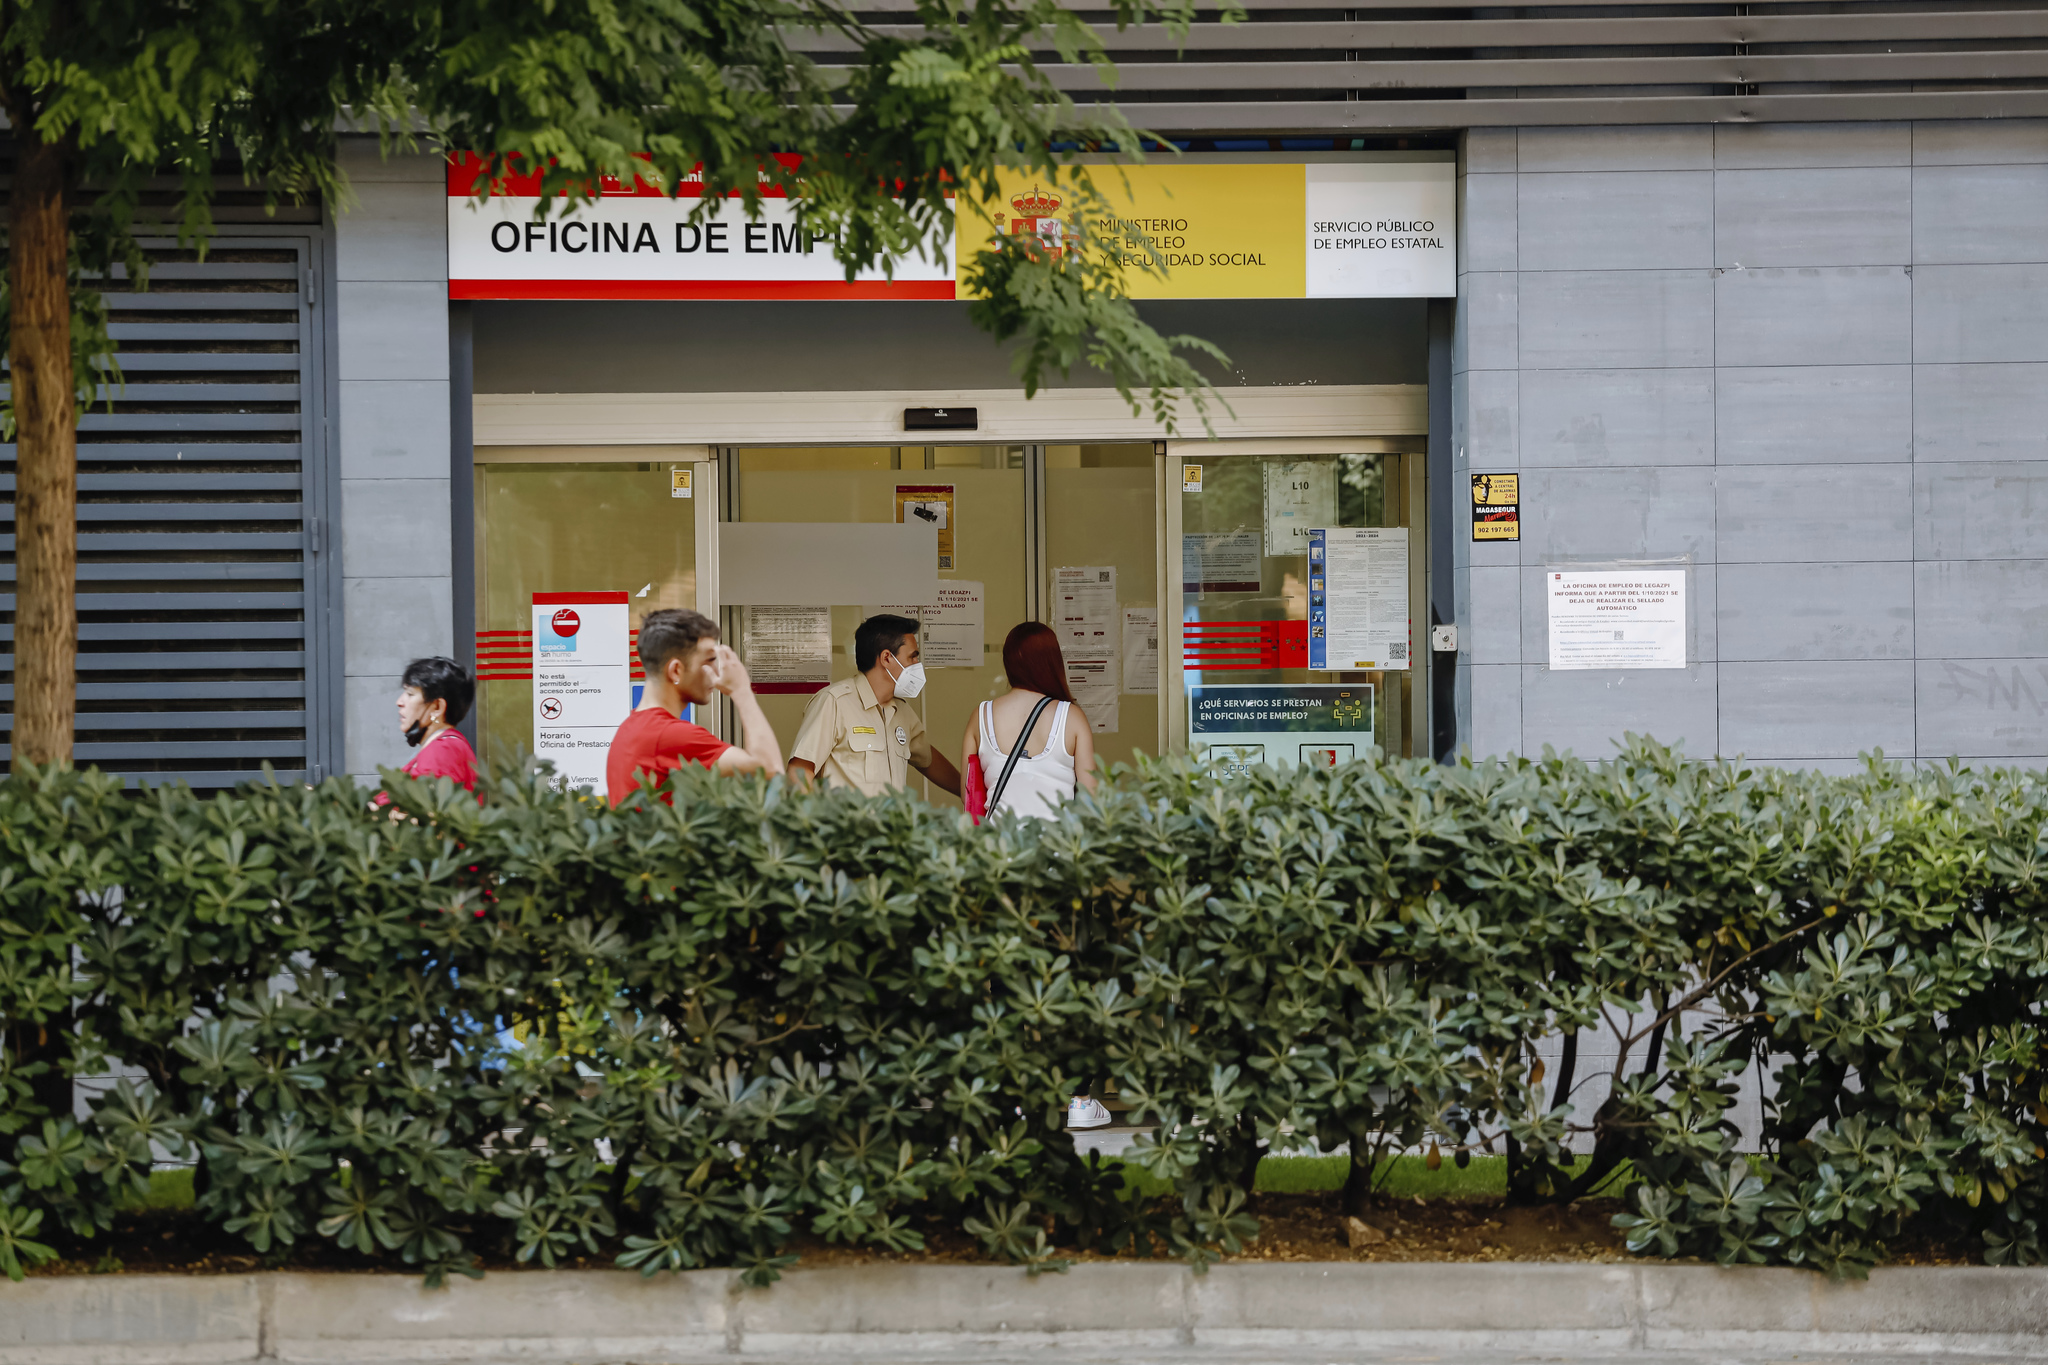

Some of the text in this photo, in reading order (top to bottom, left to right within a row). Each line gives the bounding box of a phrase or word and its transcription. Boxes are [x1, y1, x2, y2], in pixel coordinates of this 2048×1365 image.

[1313, 218, 1435, 233] SERVICIO PÚBLICO
[491, 221, 916, 254] OFICINA DE EMP
[1314, 237, 1444, 250] DE EMPLEO ESTATAL
[1100, 253, 1110, 267] Y
[1209, 253, 1267, 266] SOCIAL
[1292, 481, 1309, 490] L10
[541, 644, 567, 652] espacio
[1199, 698, 1221, 709] ¿QUÉ
[1271, 699, 1281, 707] SE
[1284, 699, 1322, 707] PRESTAN
[1214, 712, 1255, 720] OFICINAS
[1257, 712, 1268, 720] DE
[1270, 711, 1308, 720] EMPLEO?
[577, 740, 611, 748] Prestacio
[571, 775, 599, 783] Viernes
